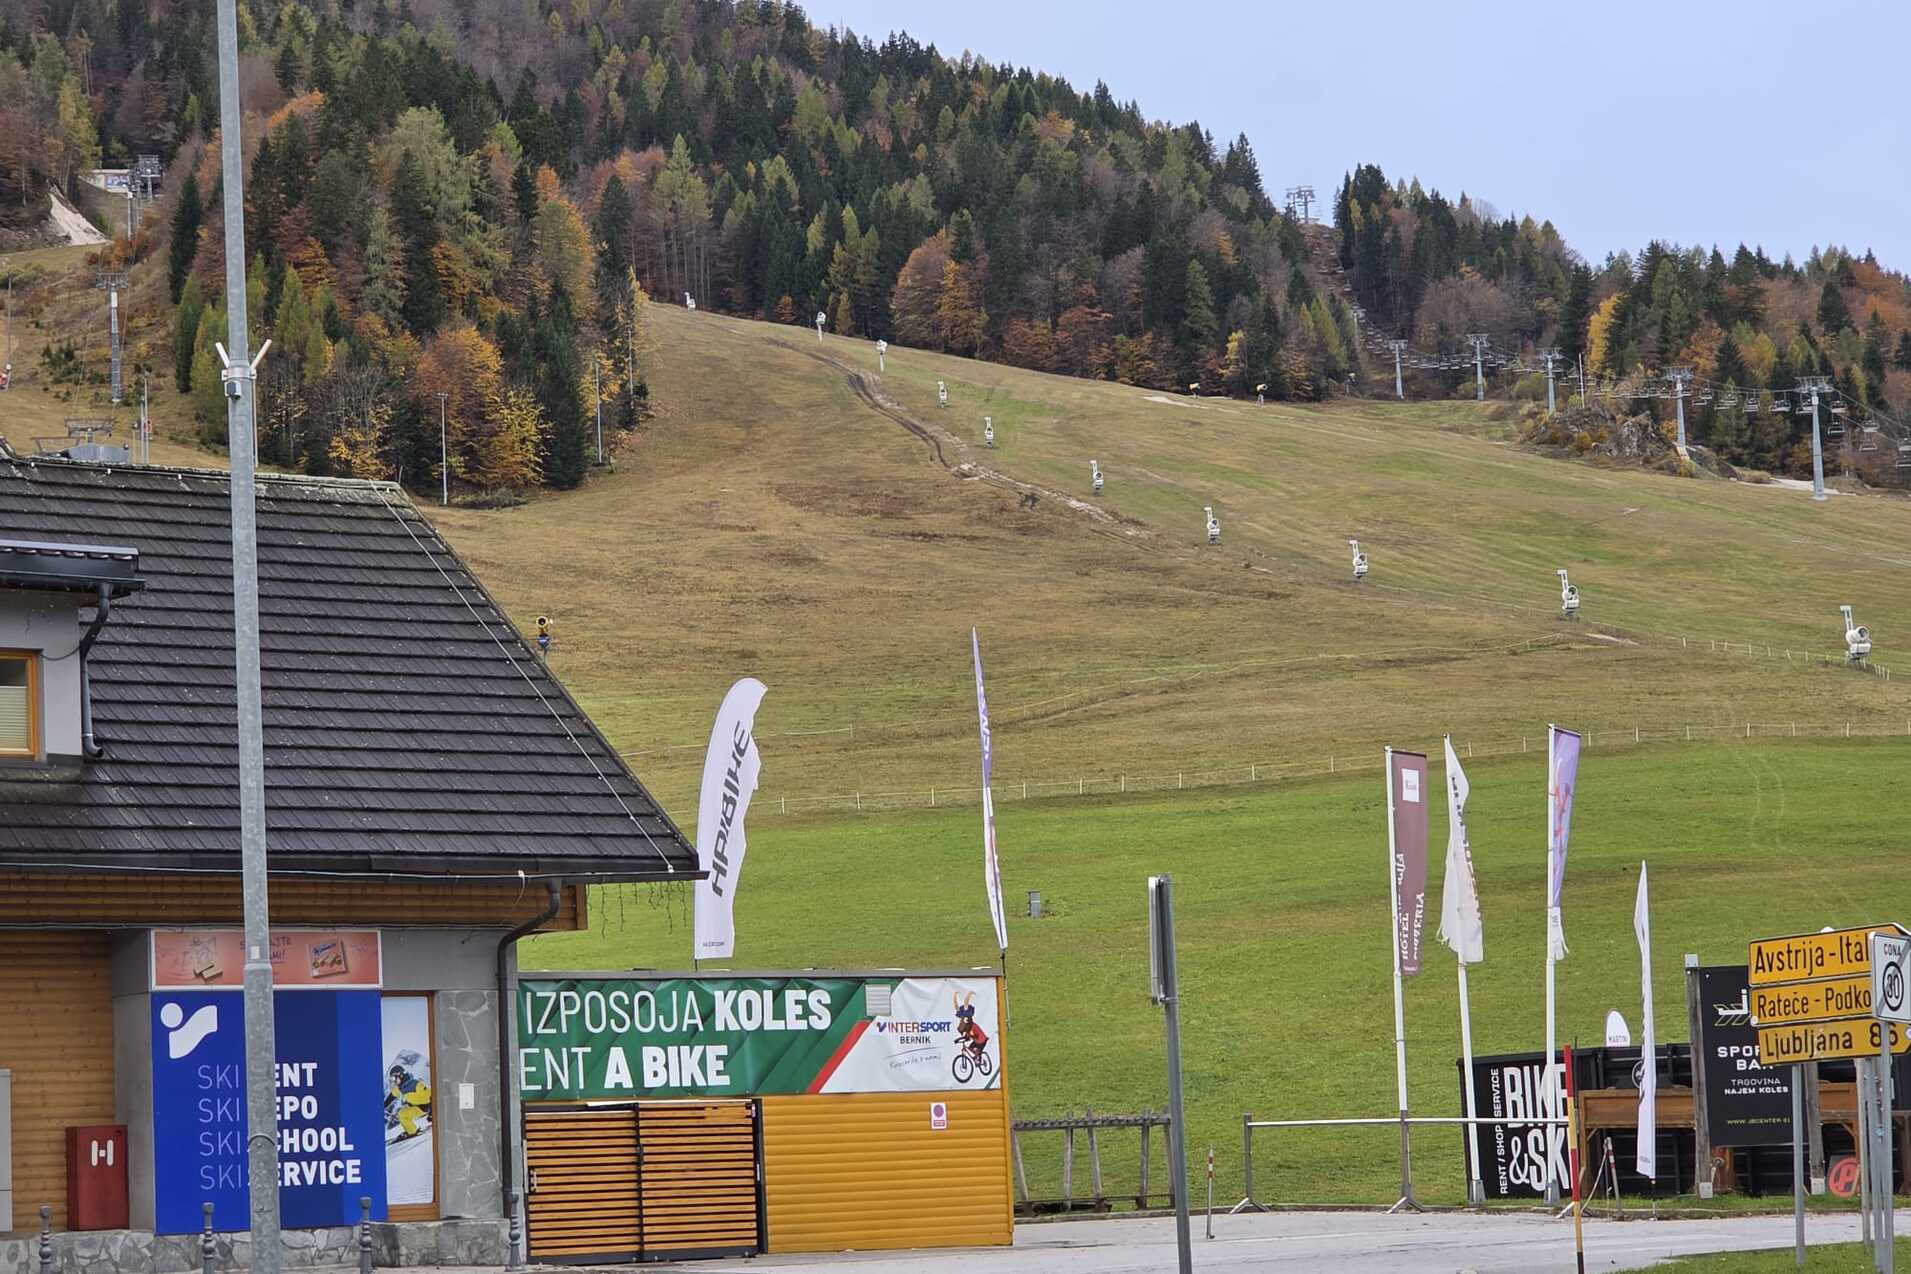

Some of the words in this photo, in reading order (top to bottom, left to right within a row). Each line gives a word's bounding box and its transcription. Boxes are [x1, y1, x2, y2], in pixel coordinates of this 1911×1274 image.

[1754, 941, 1825, 976] Avstrija
[1839, 932, 1870, 965] Ital
[1757, 991, 1809, 1018] Rateče
[1825, 984, 1872, 1012] Podko
[1886, 973, 1900, 999] 30
[526, 990, 704, 1034] IZPOSOJA
[713, 989, 832, 1032] KOLES
[888, 1021, 951, 1033] INTERSPORT
[899, 1035, 932, 1045] BERNIK
[1765, 1028, 1853, 1059] Ljubljana
[198, 1064, 240, 1089] SKI
[519, 1046, 592, 1091] ENT
[604, 1046, 634, 1089] A
[642, 1045, 731, 1088] BIKE
[1490, 1067, 1502, 1118] SERVICE
[1503, 1063, 1569, 1129] BIKE
[1724, 1086, 1756, 1095] NAJEM
[198, 1097, 241, 1123] SKI
[199, 1130, 241, 1156] SKI
[1495, 1124, 1505, 1156] SHOP
[200, 1164, 242, 1190] SKI
[1500, 1165, 1508, 1195] RENT
